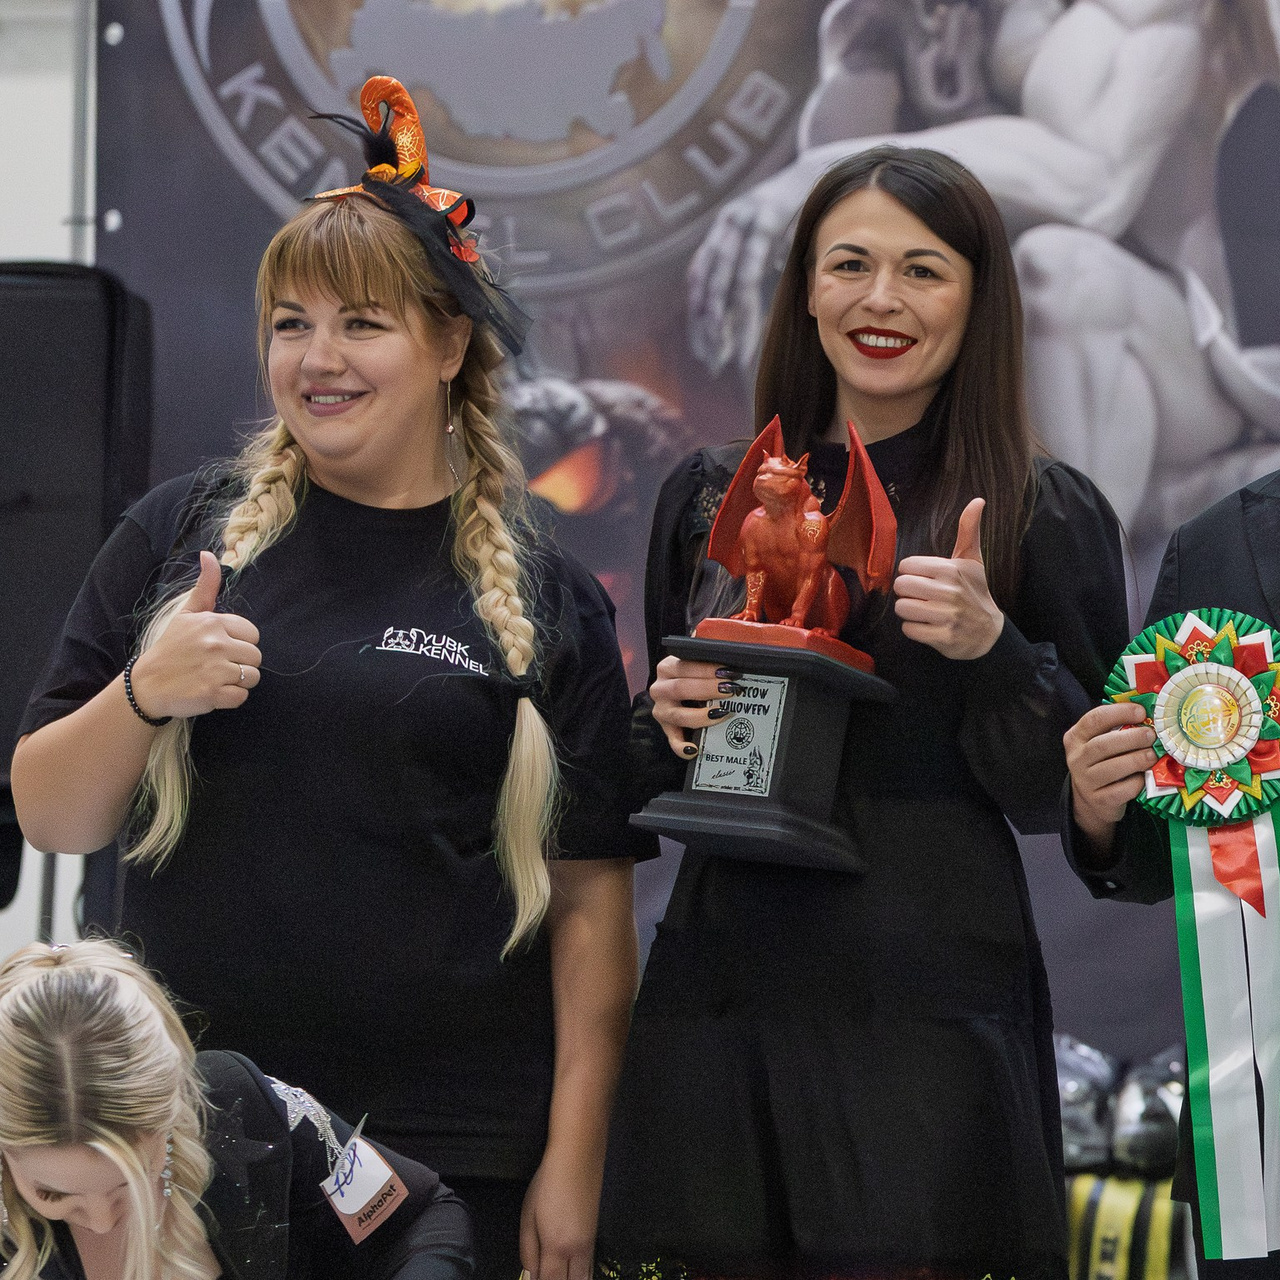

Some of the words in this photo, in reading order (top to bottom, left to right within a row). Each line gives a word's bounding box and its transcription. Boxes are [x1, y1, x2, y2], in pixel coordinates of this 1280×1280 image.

[586, 69, 792, 249] CLUB
[420, 631, 470, 657] YUBK
[420, 643, 489, 676] KENNEL
[705, 753, 726, 763] BEST
[726, 755, 748, 766] MALE
[357, 1183, 397, 1227] AlphaPet
